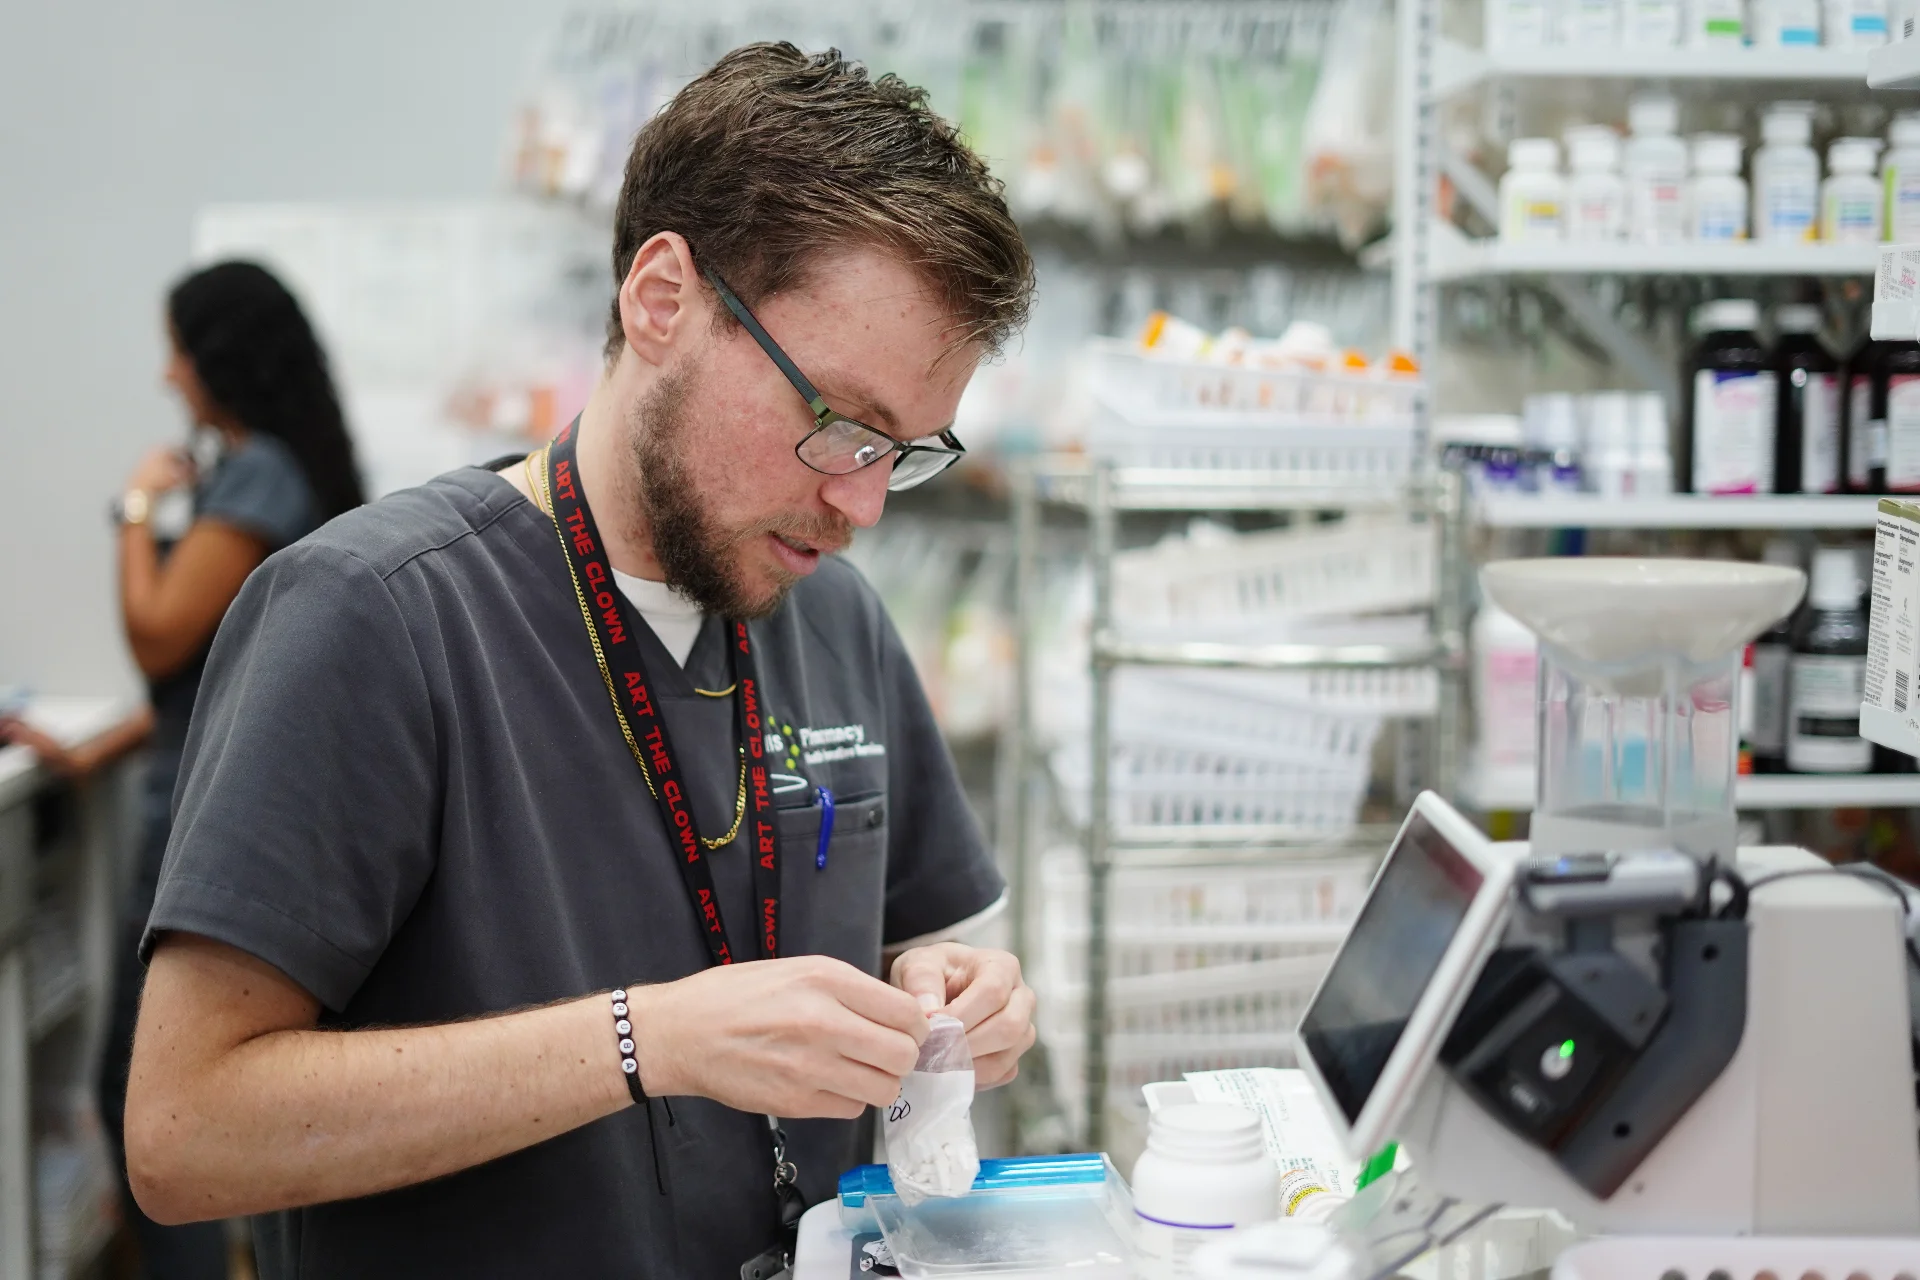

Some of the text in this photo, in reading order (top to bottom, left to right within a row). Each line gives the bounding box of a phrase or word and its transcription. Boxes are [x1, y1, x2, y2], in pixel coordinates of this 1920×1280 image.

[555, 460, 577, 501] ART
[565, 507, 595, 557] THE
[584, 561, 627, 645] CLOWN
[736, 622, 750, 655] AR
[623, 671, 700, 863] ART THE CLOWN
[742, 679, 775, 870] ART THE CLOWN
[697, 888, 732, 966] ART T
[763, 898, 777, 960] OWN
